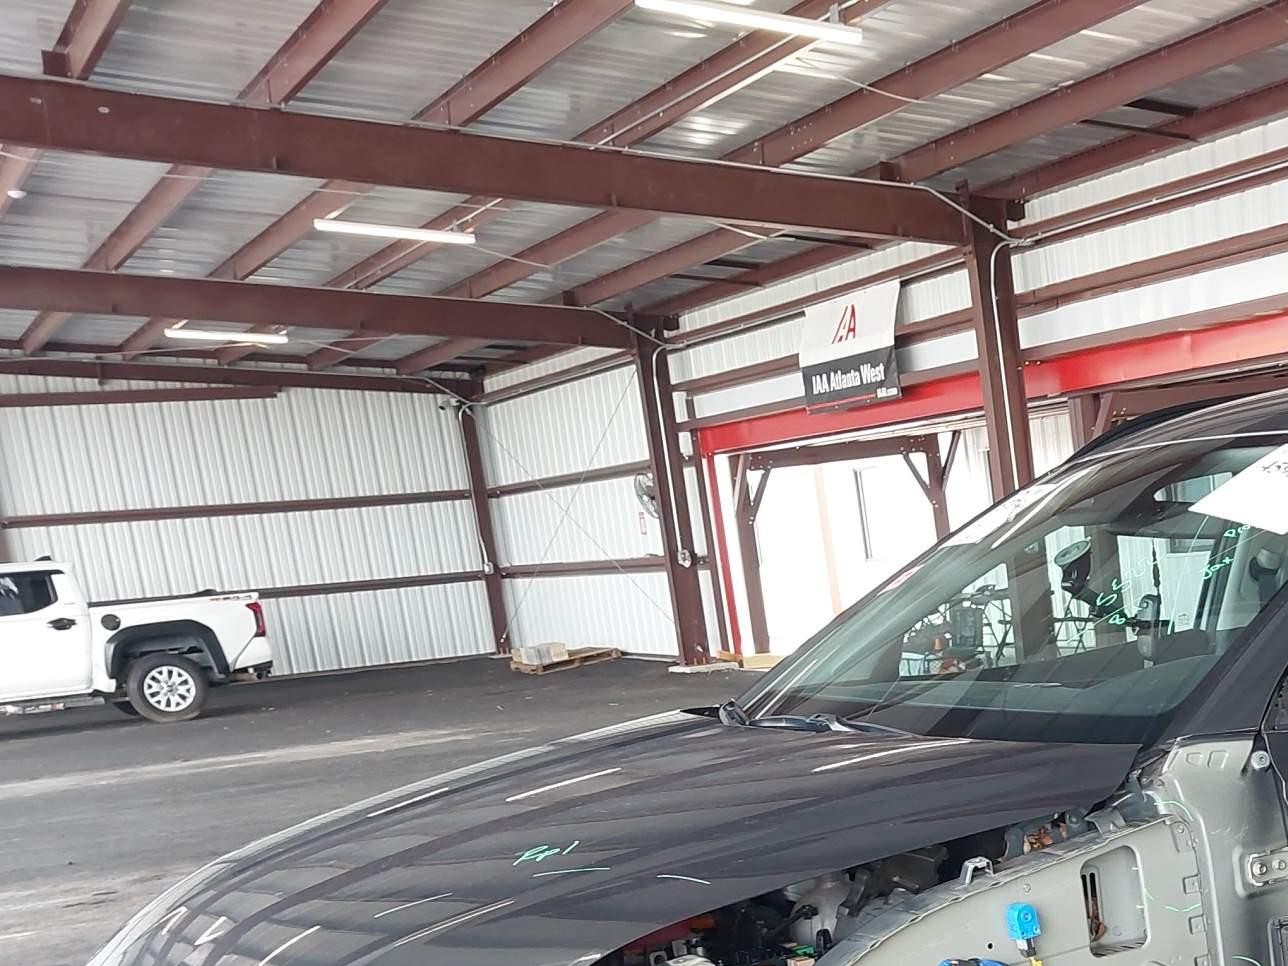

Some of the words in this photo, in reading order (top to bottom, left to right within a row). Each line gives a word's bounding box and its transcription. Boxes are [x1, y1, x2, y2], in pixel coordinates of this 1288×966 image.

[811, 373, 830, 395] IAA
[830, 369, 861, 392] Atlanta
[860, 362, 885, 385] West
